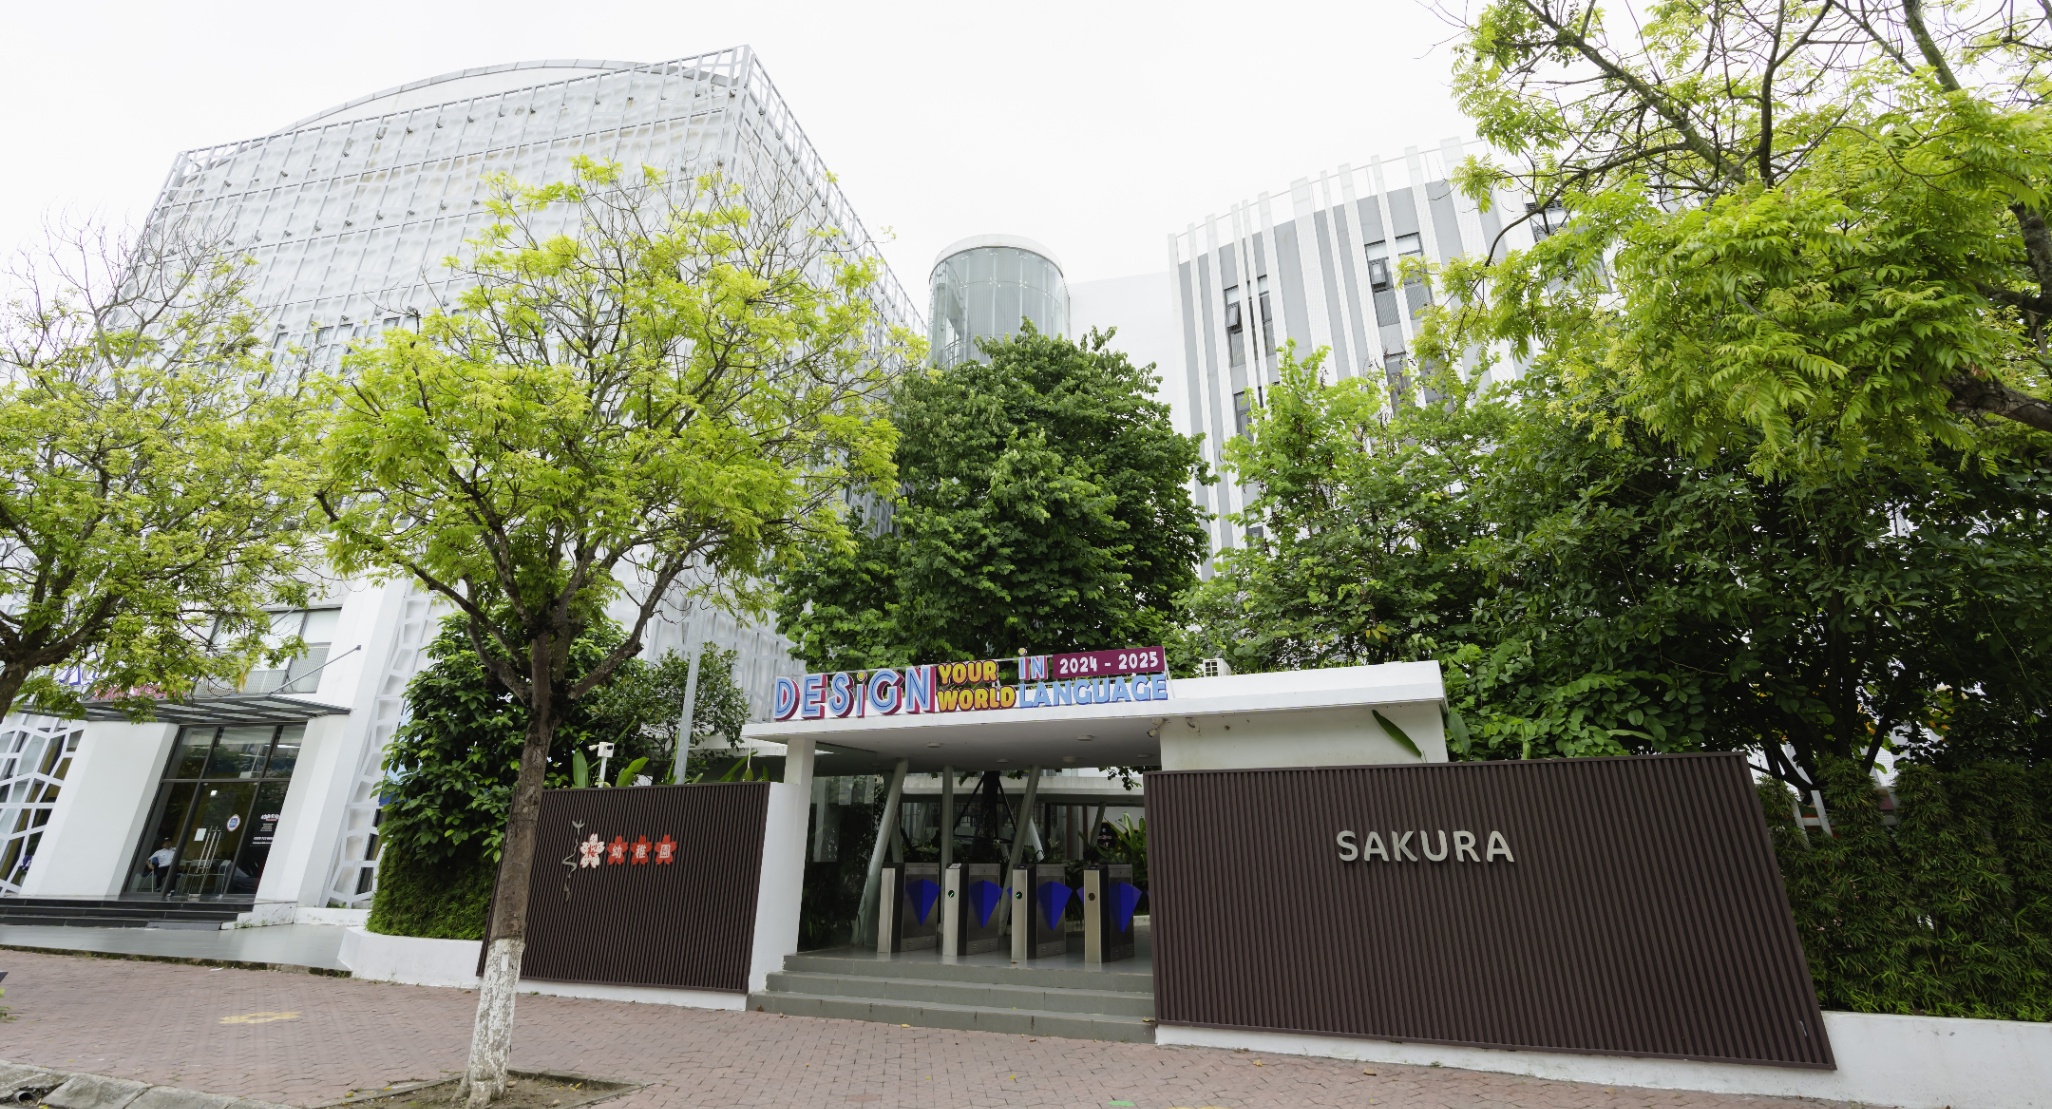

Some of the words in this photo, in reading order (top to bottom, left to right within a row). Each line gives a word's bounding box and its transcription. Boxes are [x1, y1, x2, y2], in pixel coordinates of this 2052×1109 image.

[937, 661, 999, 685] YOUR
[1059, 658, 1098, 674] 2024
[1118, 651, 1159, 670] 2025
[937, 686, 1016, 711] WORLD
[1018, 674, 1168, 708] LANGUAGE
[1336, 829, 1515, 863] SAKURA
